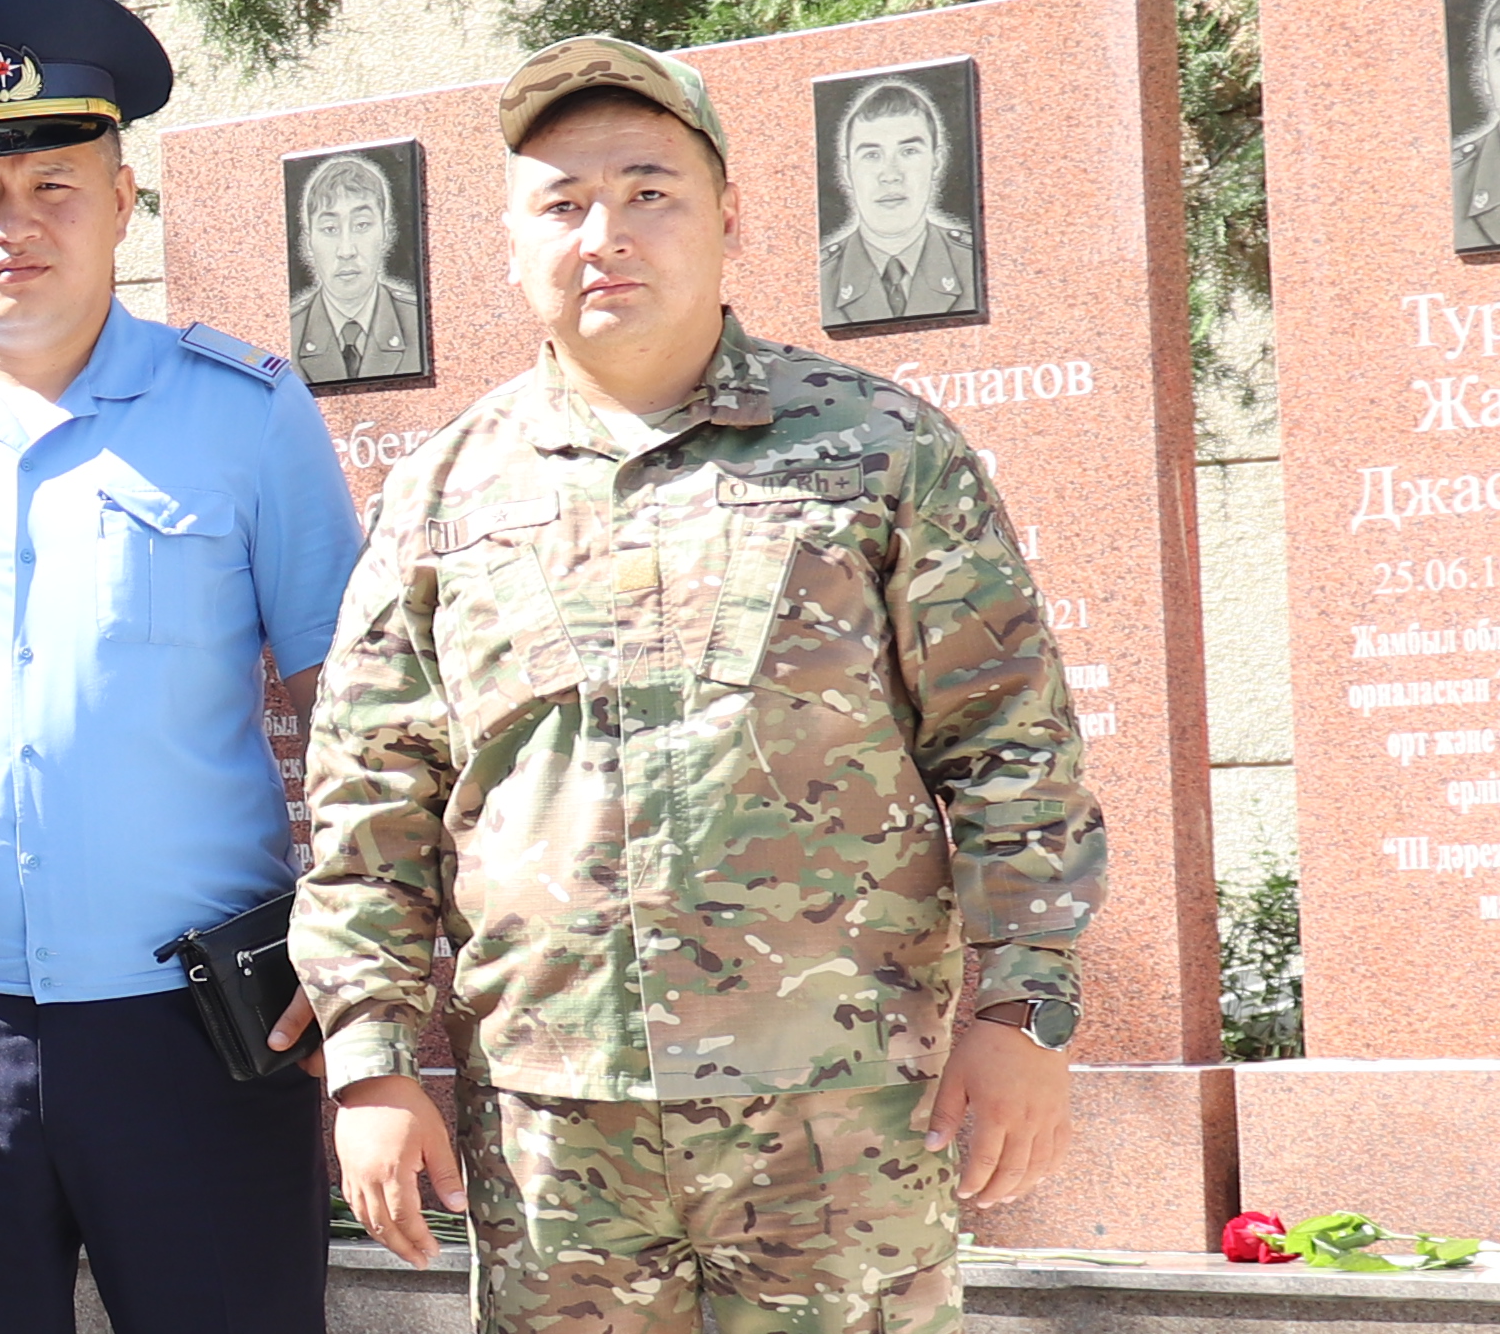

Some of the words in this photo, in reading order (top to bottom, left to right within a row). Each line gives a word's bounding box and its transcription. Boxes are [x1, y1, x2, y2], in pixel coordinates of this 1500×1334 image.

[1401, 293, 1500, 359] Тур
[1412, 374, 1500, 433] Жа
[1373, 556, 1497, 594] 25.06.1
[1351, 622, 1457, 658] Жамбыл
[1386, 732, 1429, 767] өрт
[1434, 728, 1496, 756] және
